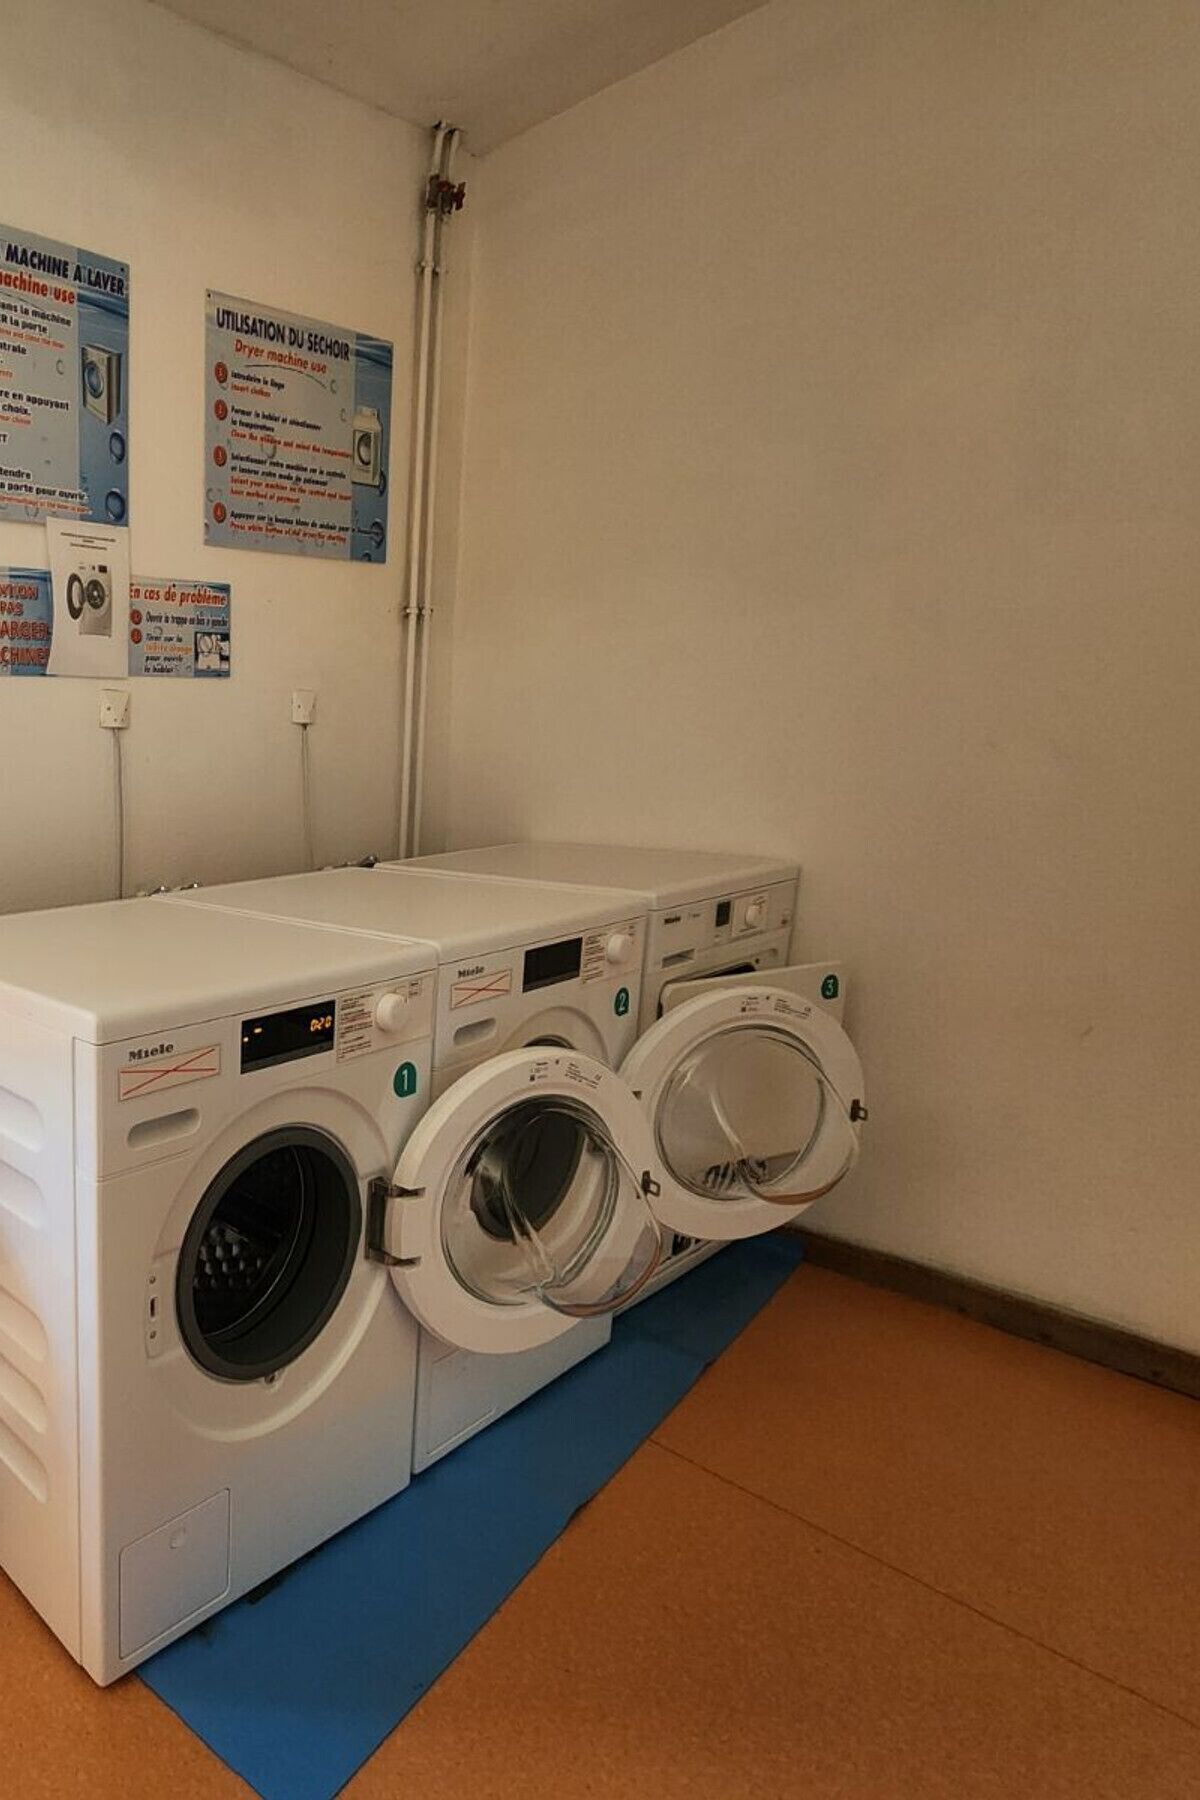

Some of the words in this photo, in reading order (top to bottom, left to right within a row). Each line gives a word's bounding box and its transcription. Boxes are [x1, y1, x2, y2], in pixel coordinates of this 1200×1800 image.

[5, 243, 69, 279] MACHINE
[87, 268, 125, 296] LAVER
[54, 286, 75, 304] use
[10, 313, 20, 327] la
[22, 318, 48, 334] porte
[20, 303, 30, 315] la
[32, 308, 72, 327] machine
[216, 307, 285, 344] UTILISATION
[289, 327, 304, 349] DU
[308, 333, 350, 361] SECHOIR
[234, 339, 264, 358] Dryer
[267, 349, 309, 369] machine
[311, 362, 327, 374] use
[12, 390, 24, 401] en
[25, 393, 69, 411] appuyant
[7, 481, 33, 495] porte
[35, 485, 57, 498] pour
[144, 588, 160, 600] cas
[164, 587, 176, 601] de
[179, 589, 227, 607] problème
[0, 601, 24, 615] PAS
[458, 965, 485, 979] Miele
[826, 979, 834, 995] 3
[619, 993, 626, 1007] 2
[128, 1042, 175, 1063] Miele
[401, 1070, 410, 1092] 1
